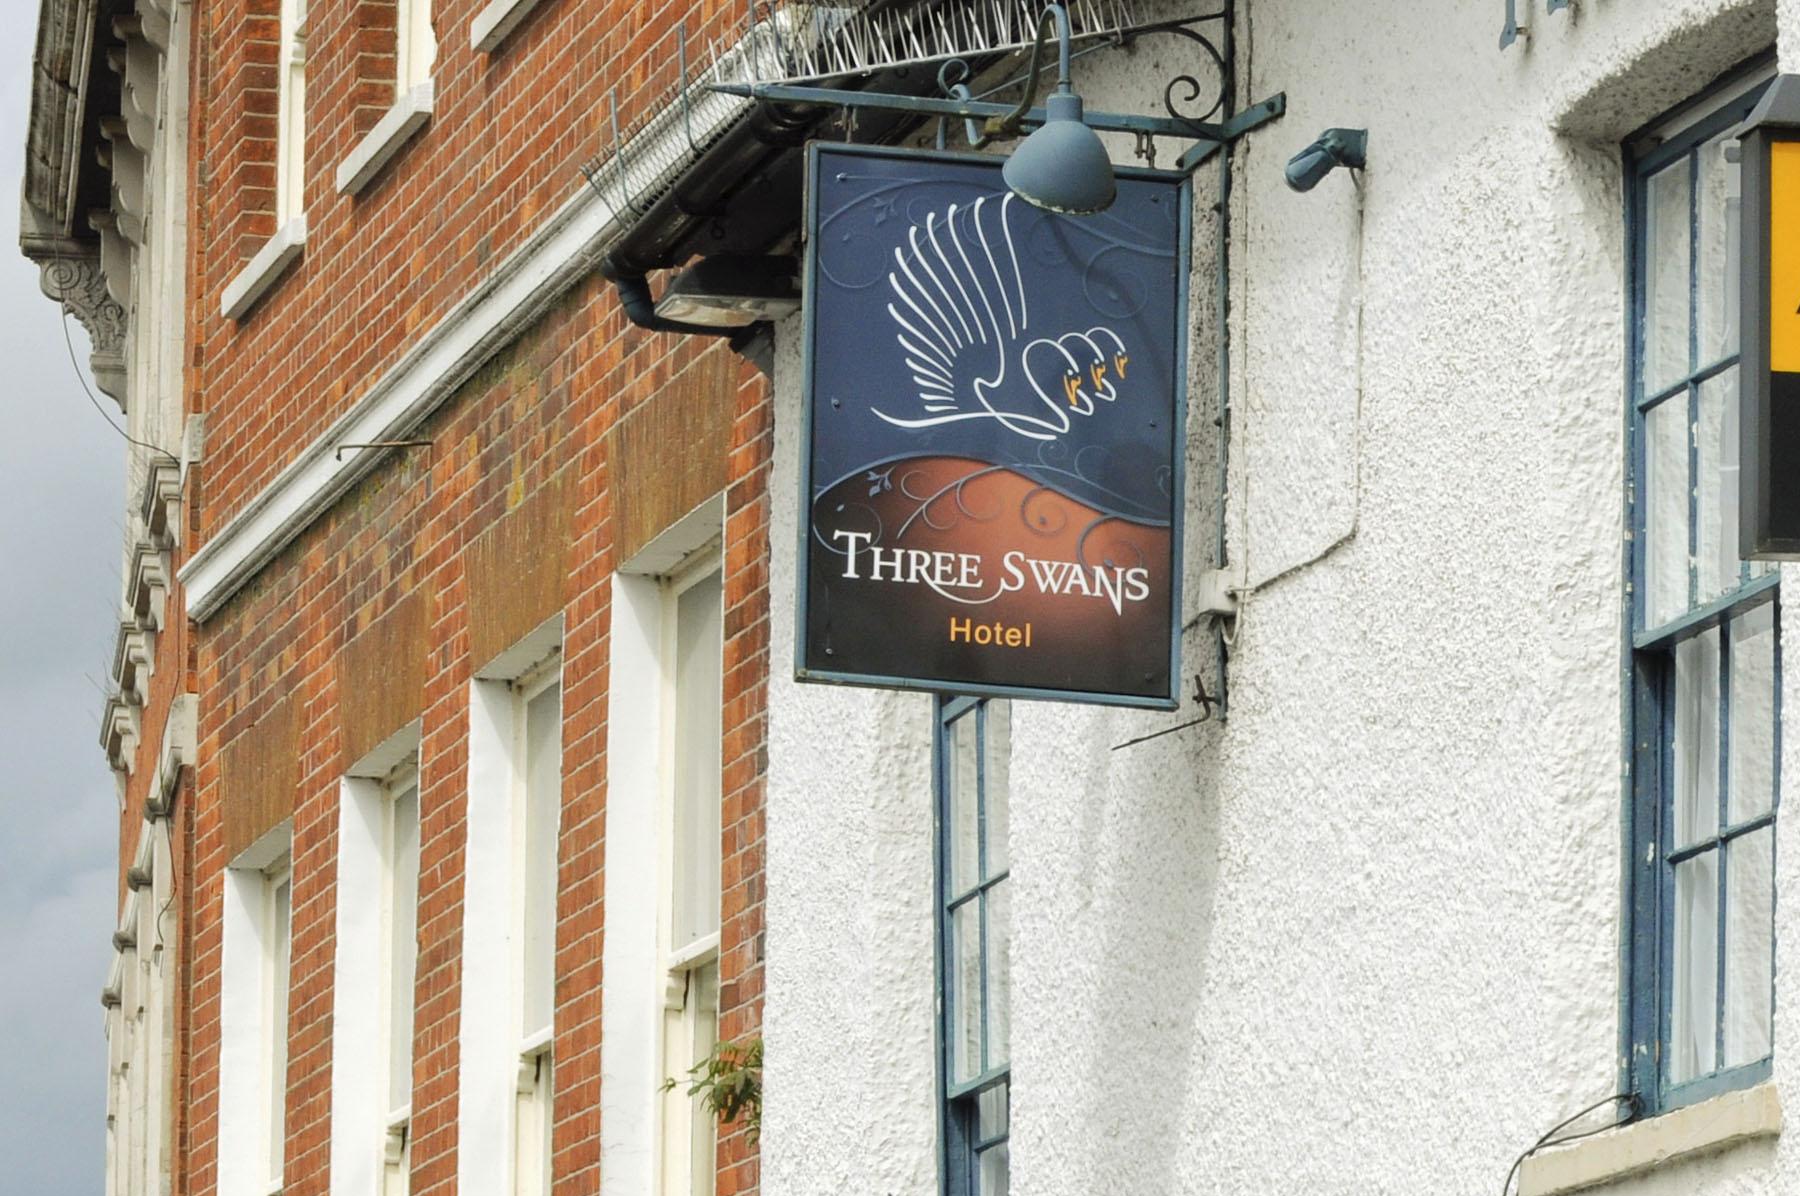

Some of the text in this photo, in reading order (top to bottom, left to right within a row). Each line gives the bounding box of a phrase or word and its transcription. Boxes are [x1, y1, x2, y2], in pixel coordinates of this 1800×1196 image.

[834, 530, 1150, 616] THREE SWANS
[950, 616, 1032, 648] Hotel
